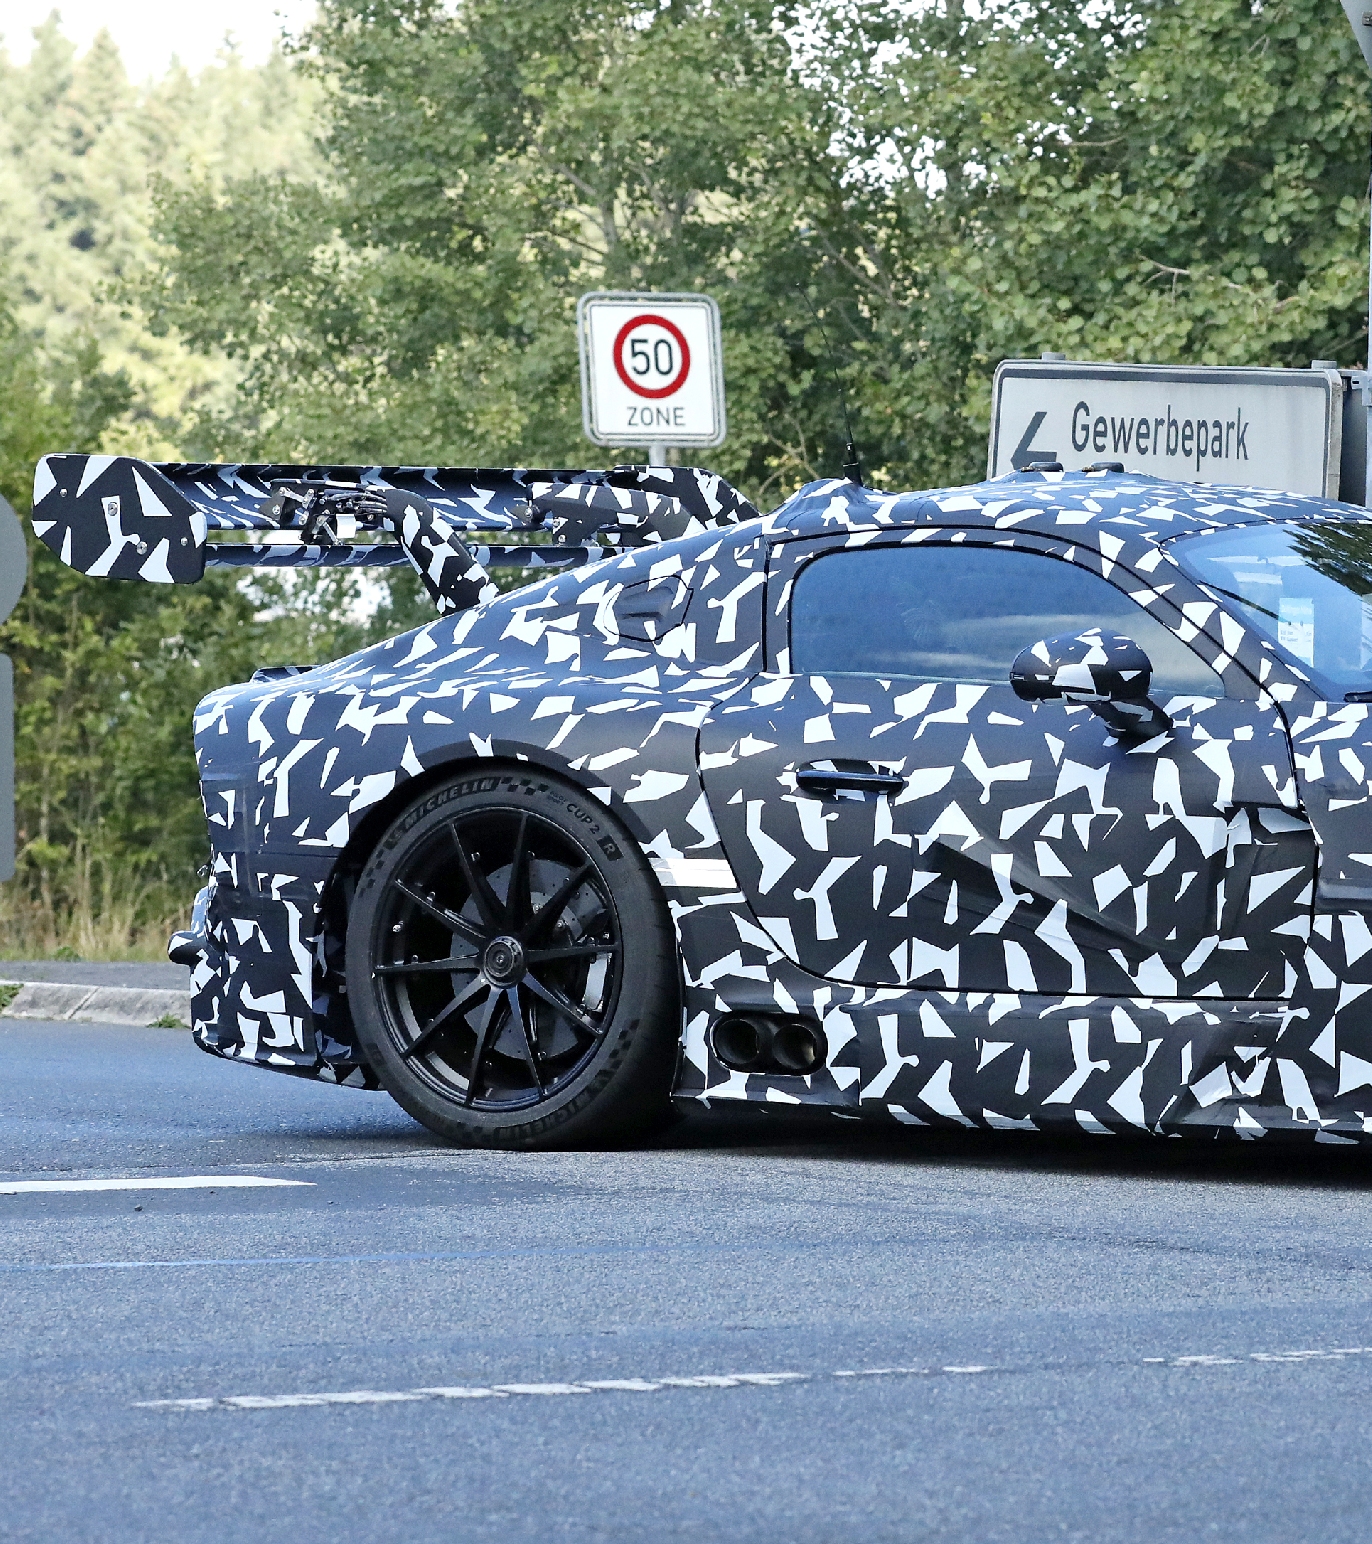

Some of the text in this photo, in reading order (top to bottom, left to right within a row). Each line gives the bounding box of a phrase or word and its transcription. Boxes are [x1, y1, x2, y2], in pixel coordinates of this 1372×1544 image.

[630, 338, 674, 376] 50
[626, 405, 686, 427] ZONE
[1070, 400, 1250, 472] Gewerbepark
[403, 778, 496, 830] MICHELIN
[566, 803, 593, 824] CUP
[589, 824, 600, 835] 2
